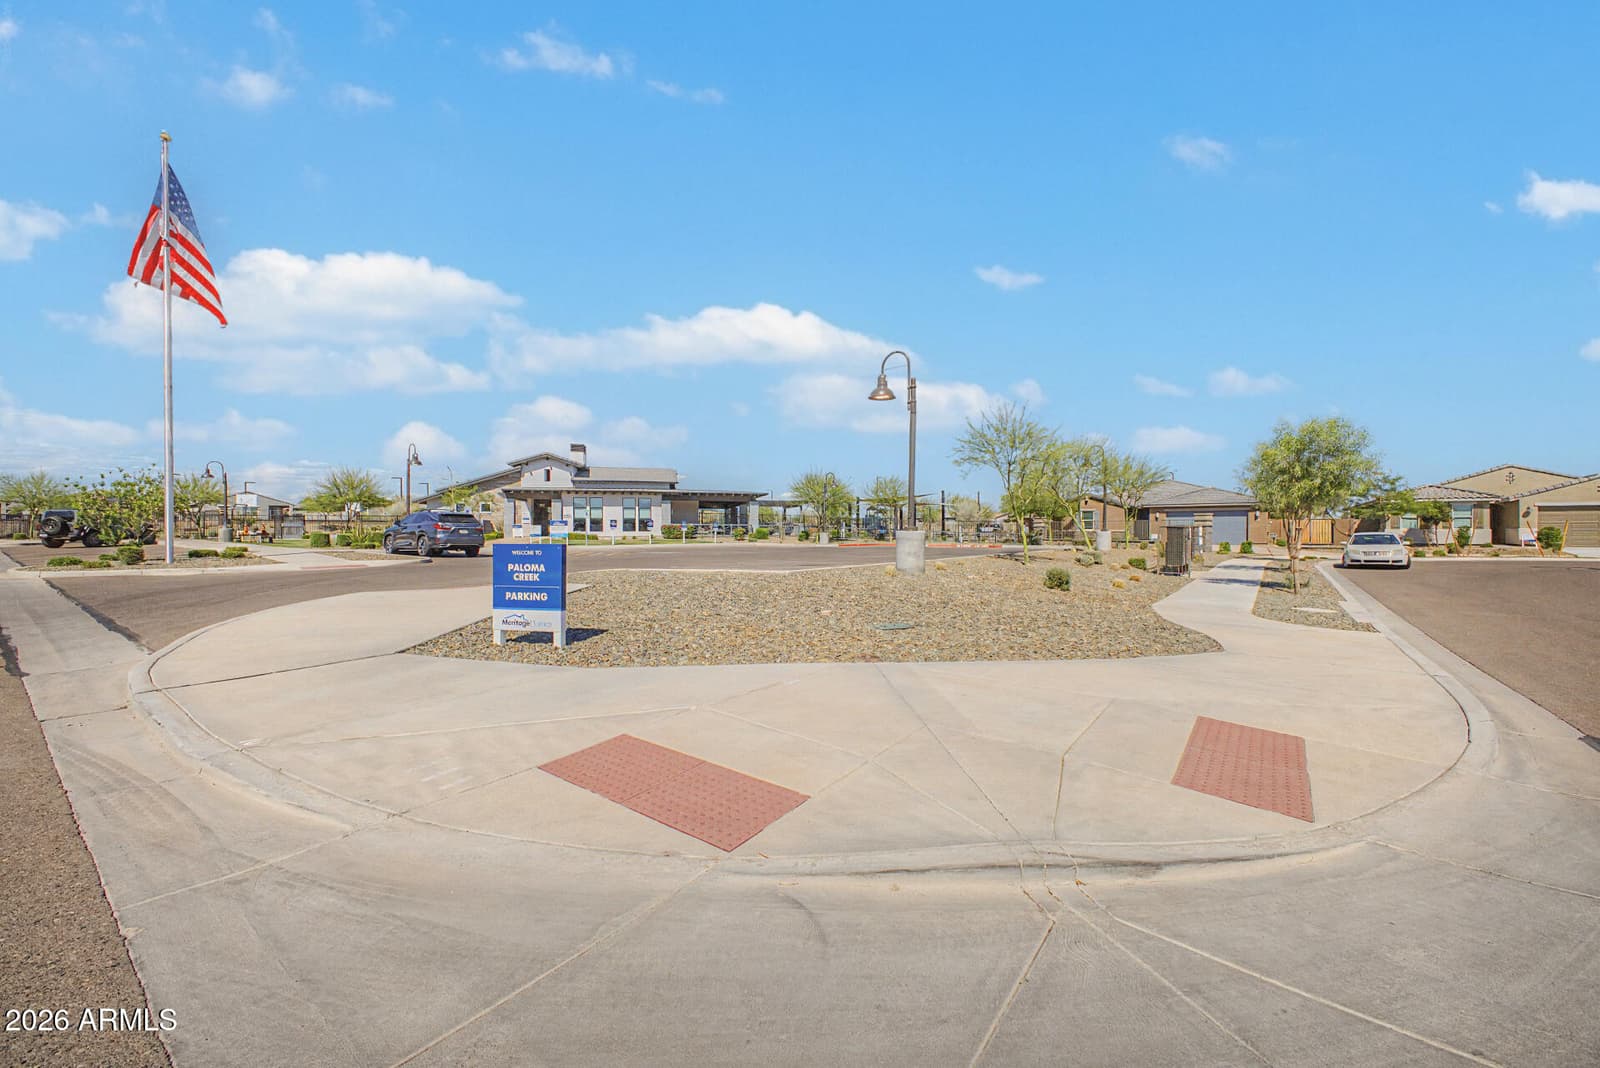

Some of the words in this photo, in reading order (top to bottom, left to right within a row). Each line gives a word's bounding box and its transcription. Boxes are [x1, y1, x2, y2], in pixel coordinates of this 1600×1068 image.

[508, 564, 546, 572] PALOMA
[513, 573, 540, 582] CREEK
[506, 592, 548, 600] PARKING
